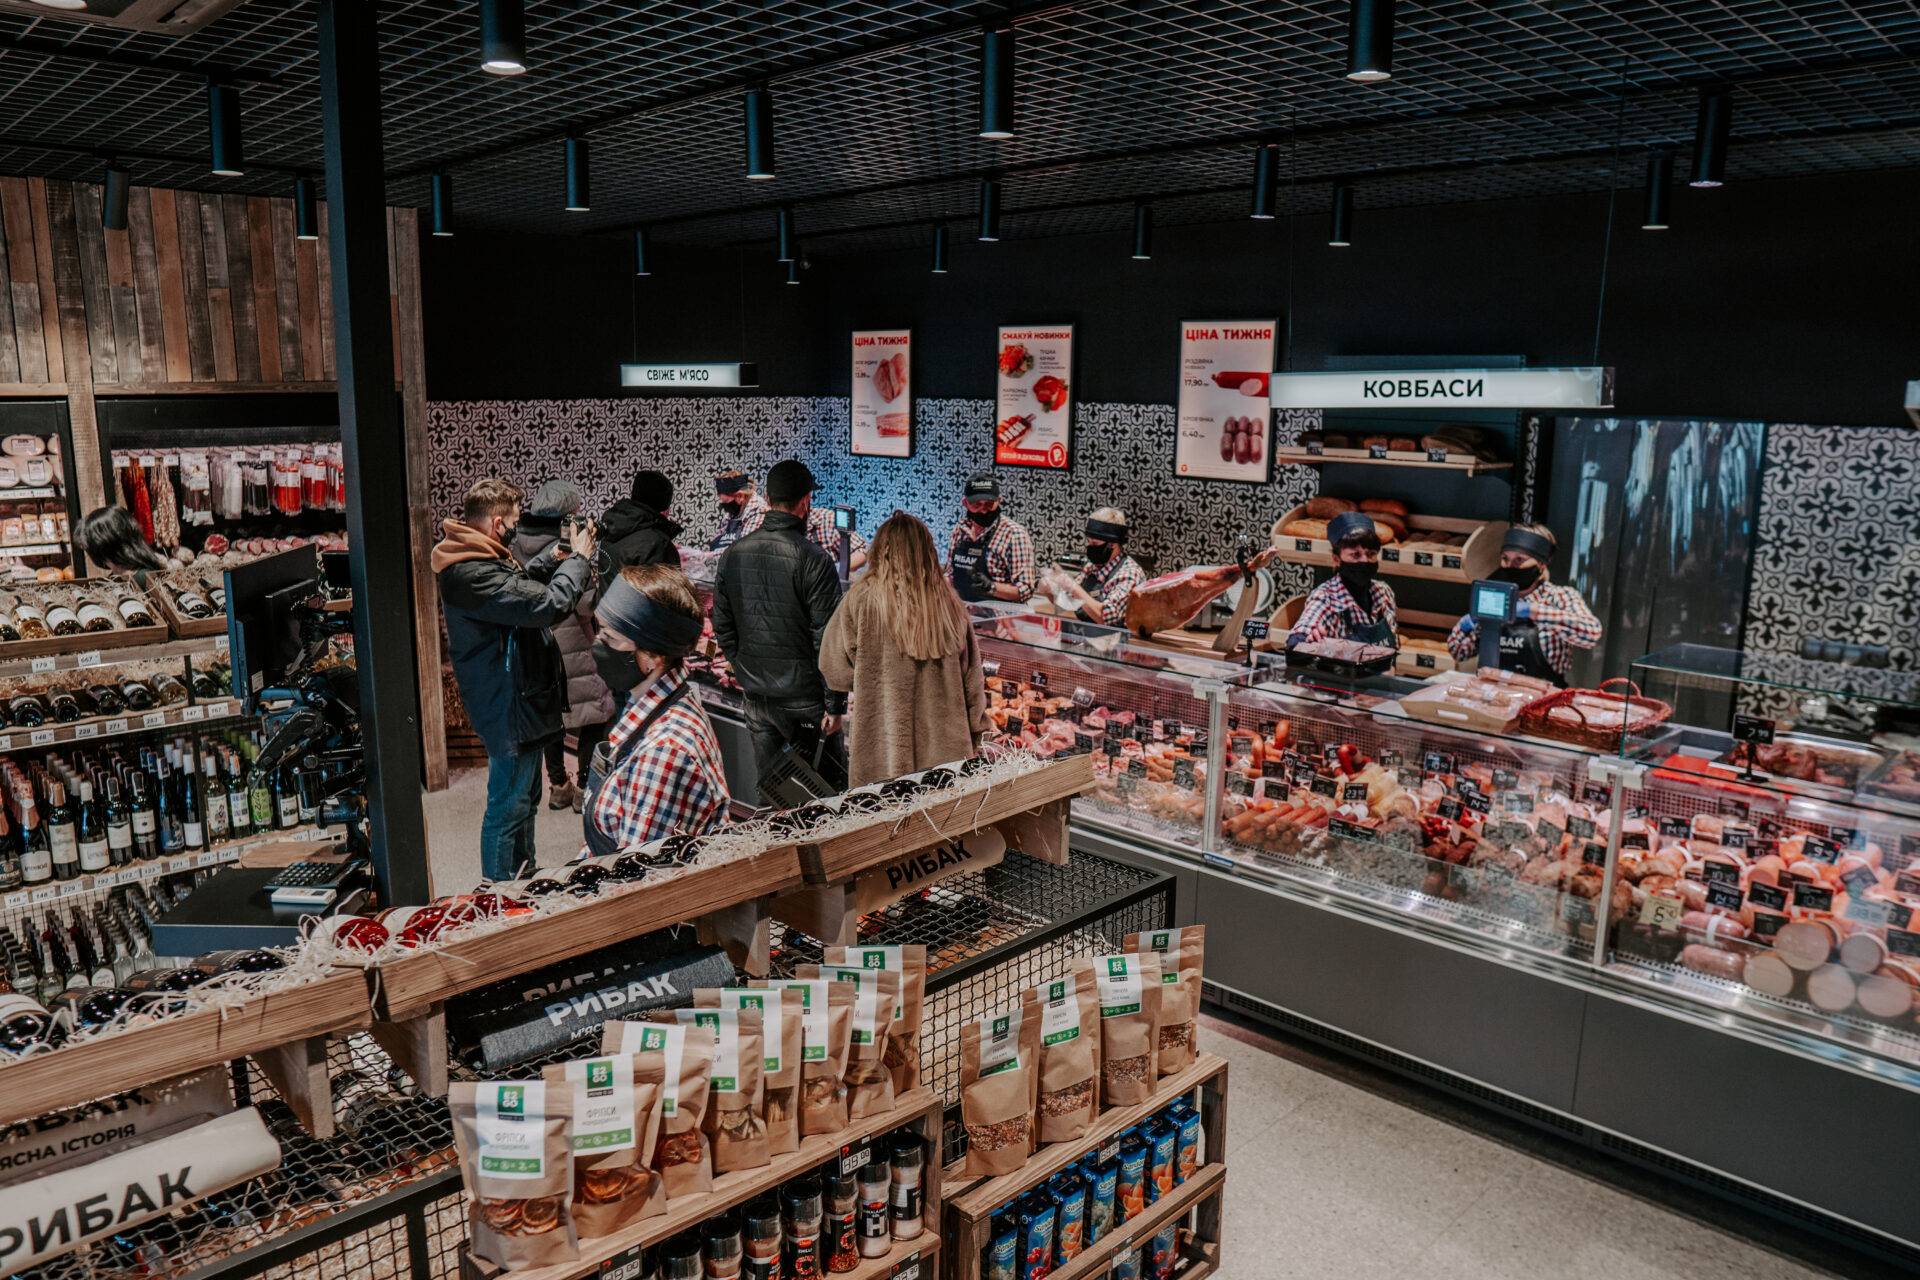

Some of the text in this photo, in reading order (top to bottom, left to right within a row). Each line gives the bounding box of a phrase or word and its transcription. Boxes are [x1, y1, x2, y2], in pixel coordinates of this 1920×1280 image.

[855, 336, 908, 347] ЦІНА ТИЖНЯ
[1002, 331, 1071, 340] СМАКУЙ НОВИНКИ
[1186, 328, 1271, 340] ЦІНА ТИЖНЯ
[646, 369, 709, 381] СВІЖЕ М'ЯСО
[1363, 379, 1484, 398] КОВБАСИ
[1499, 636, 1524, 649] БАК
[886, 839, 973, 890] РИБАК
[544, 972, 679, 1027] РИБАК
[570, 1022, 605, 1041] М'ЯС
[62, 1123, 136, 1154] ІСТОРІЯ
[0, 1166, 196, 1269] РИБАК
